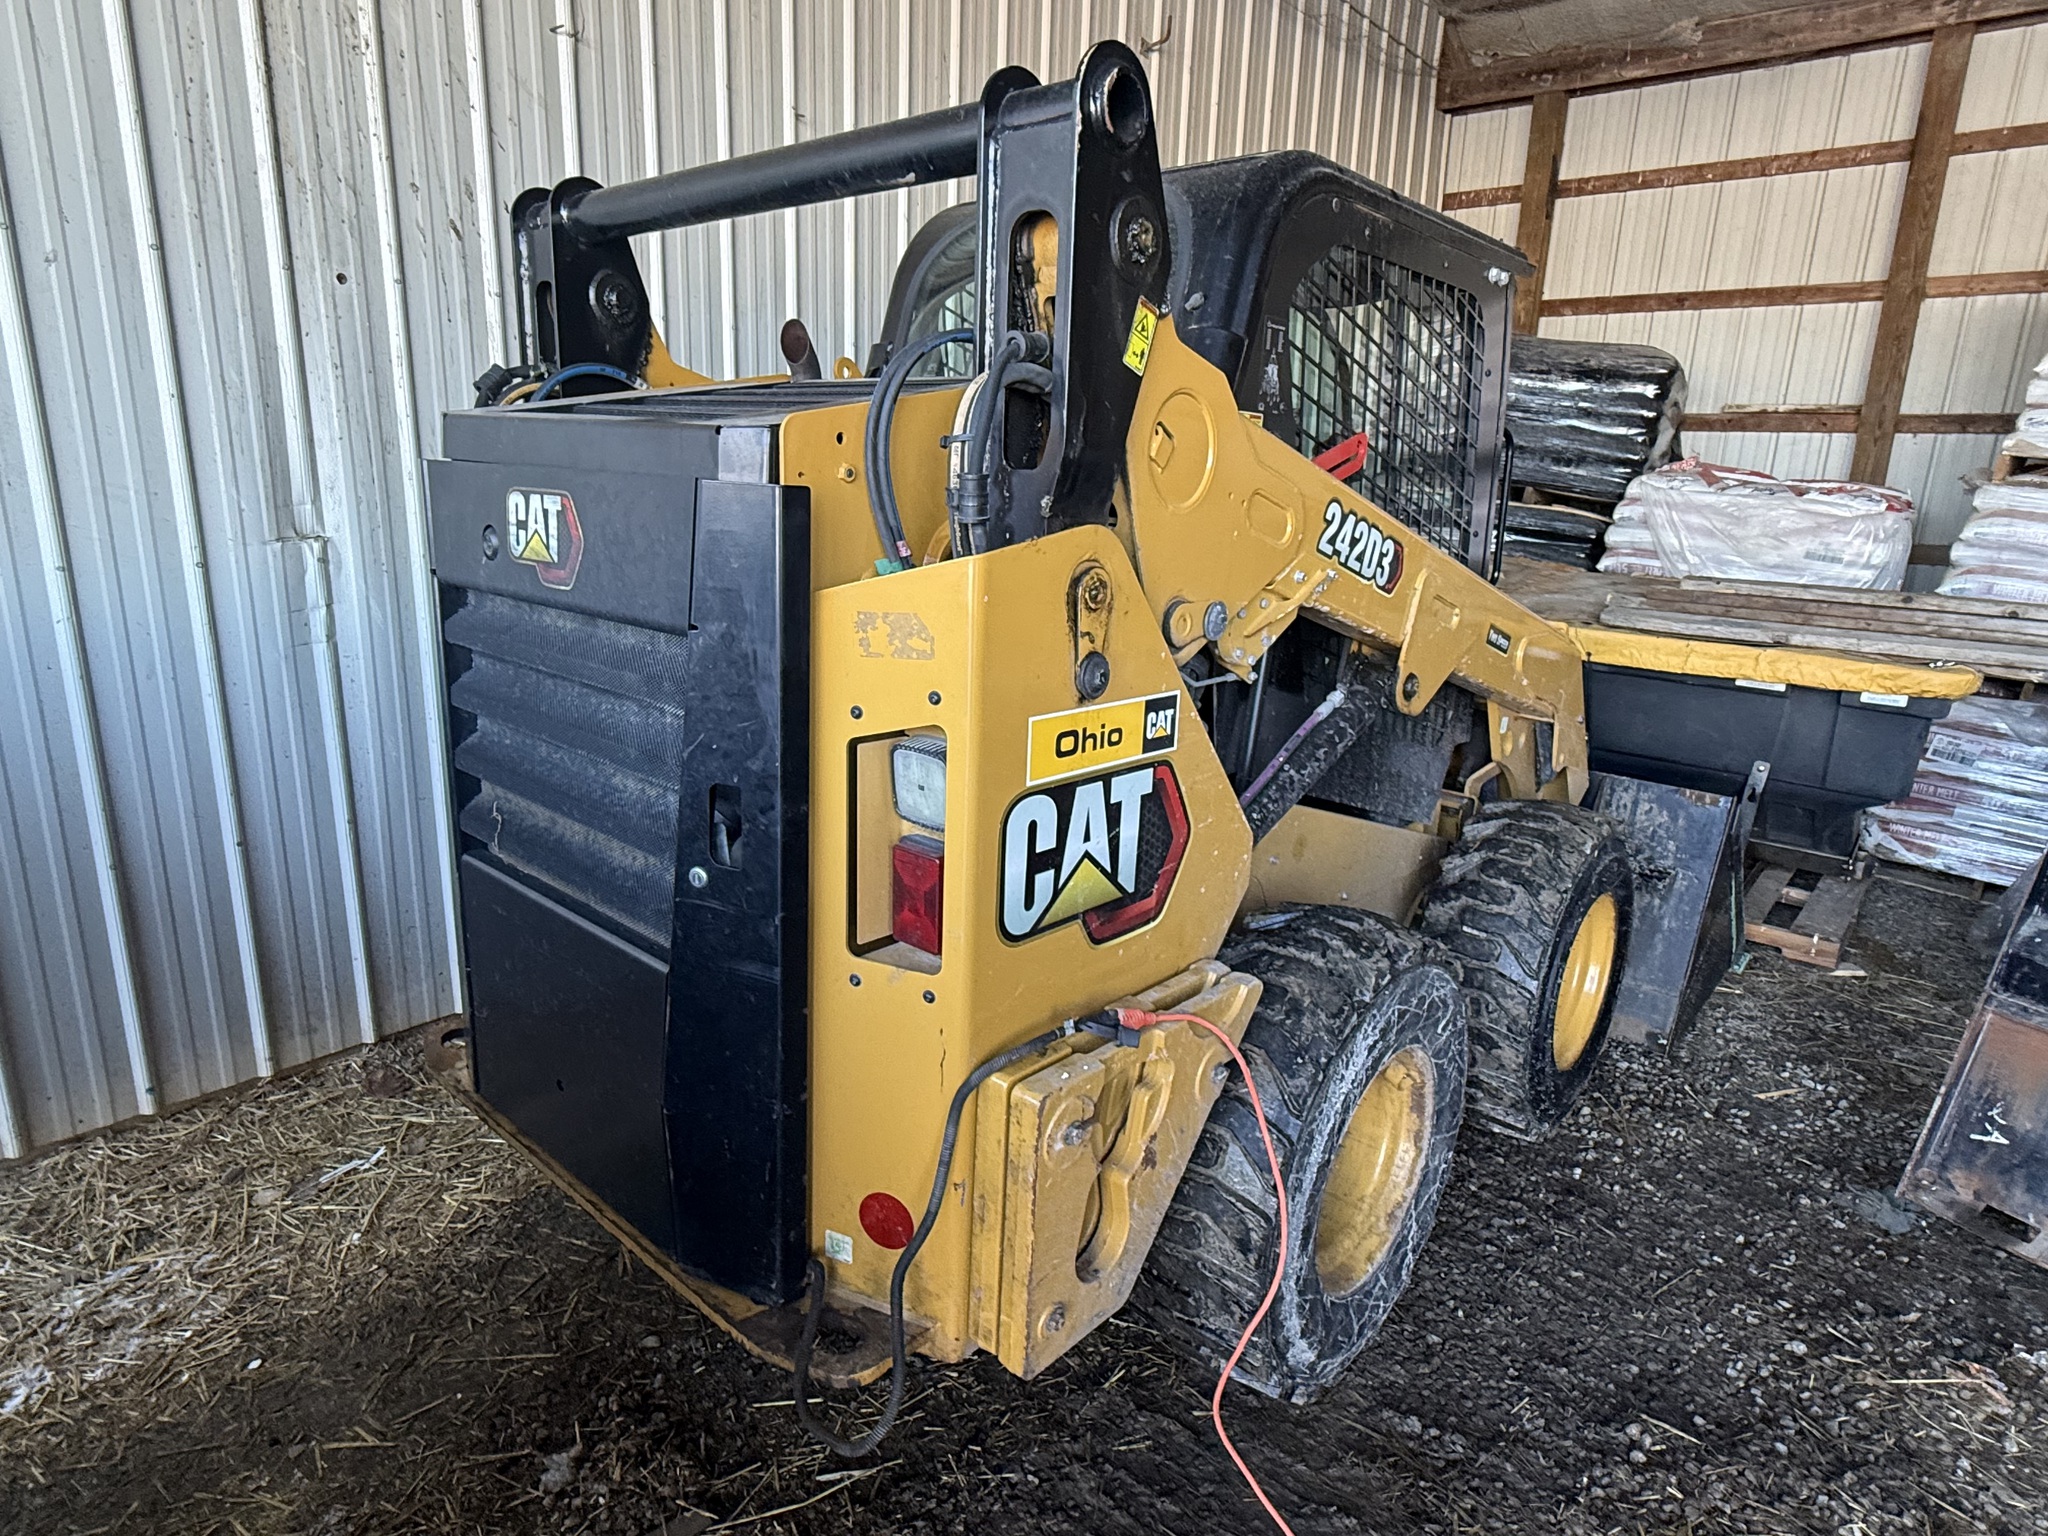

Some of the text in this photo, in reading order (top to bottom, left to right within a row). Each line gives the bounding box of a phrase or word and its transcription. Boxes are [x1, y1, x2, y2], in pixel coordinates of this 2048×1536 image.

[508, 490, 562, 564] CAT
[1318, 502, 1395, 587] 242D3
[1055, 723, 1123, 758] Ohio
[1146, 708, 1175, 740] CAT
[1936, 787, 1959, 800] MELT
[1890, 822, 1922, 837] WINTER
[1003, 767, 1154, 936] CAT
